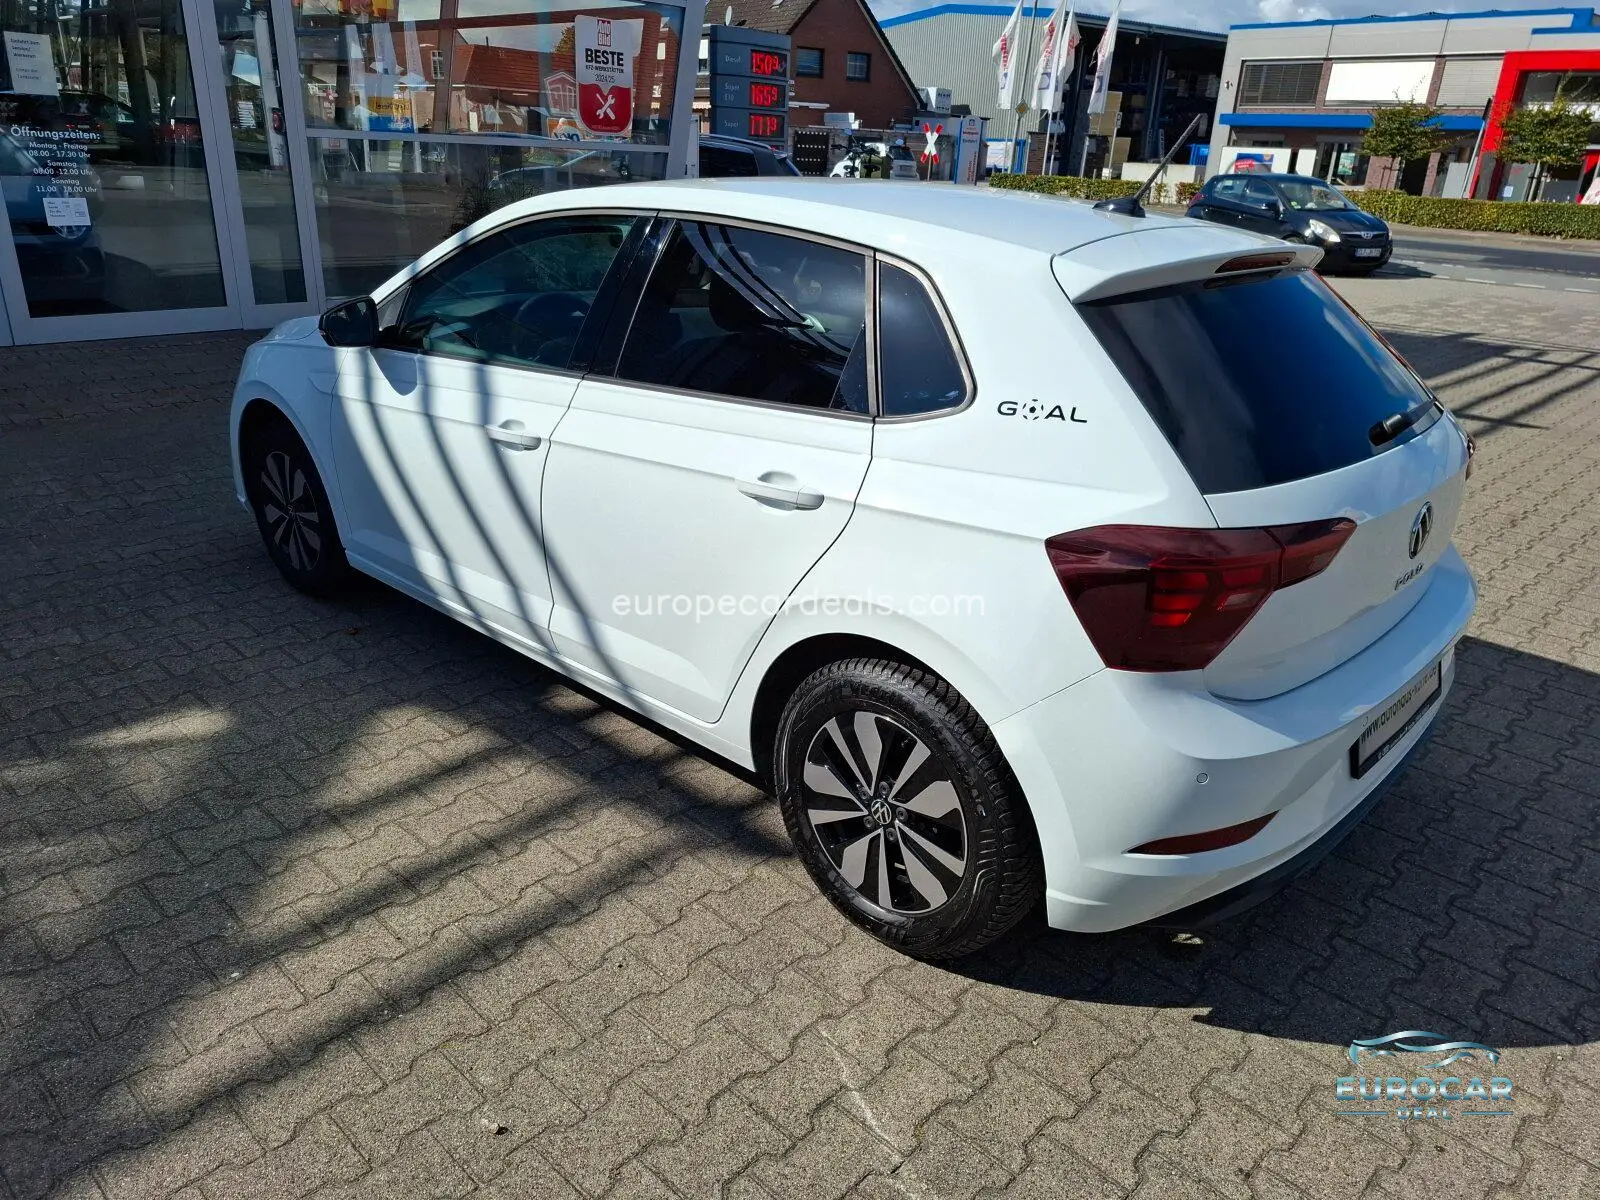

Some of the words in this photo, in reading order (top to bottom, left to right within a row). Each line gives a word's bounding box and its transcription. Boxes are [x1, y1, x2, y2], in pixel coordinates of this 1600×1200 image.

[585, 48, 624, 67] BESTE
[725, 55, 741, 63] Diesel
[724, 82, 740, 91] Super
[724, 120, 739, 128] Super
[10, 124, 101, 140] Öffnungszeiten:
[29, 141, 57, 150] Montag
[63, 142, 88, 151] Freitag
[57, 150, 77, 158] 17.30
[47, 159, 77, 168] Samstag
[80, 168, 93, 176] Uhr
[51, 177, 80, 186] Sonntag
[997, 399, 1087, 423] GOAL
